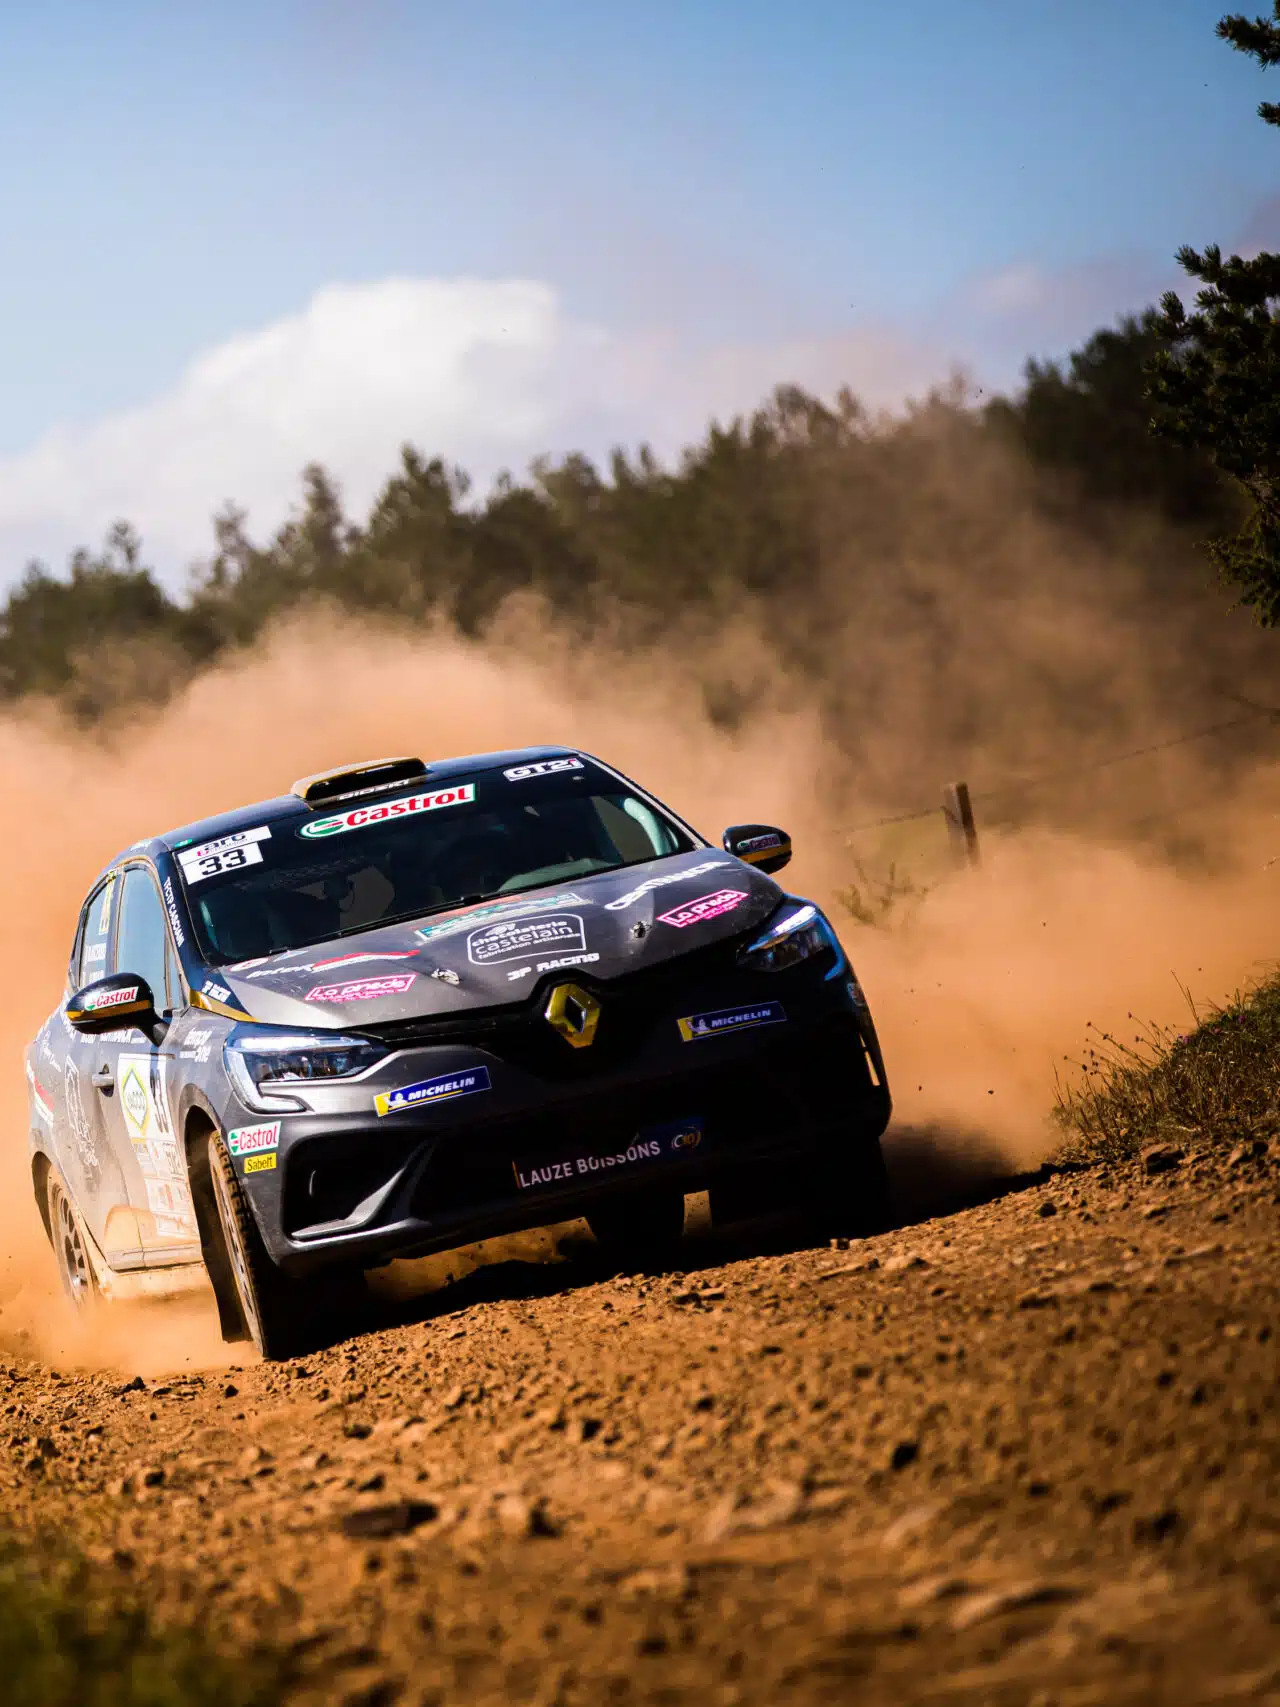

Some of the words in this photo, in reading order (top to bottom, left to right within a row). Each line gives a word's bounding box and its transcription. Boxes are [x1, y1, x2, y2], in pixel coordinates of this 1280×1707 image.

[346, 787, 471, 826] Castrol
[198, 849, 248, 876] 33
[471, 920, 568, 947] chocolaterie
[475, 924, 573, 955] castelain
[478, 940, 532, 960] fabrication
[532, 932, 582, 945] artisanale
[536, 953, 600, 973] RACING
[96, 988, 136, 1007] Castrol
[710, 1009, 772, 1028] MICHELIN
[407, 1076, 476, 1101] MICHELIN
[239, 1127, 279, 1151] Castrol
[246, 1155, 274, 1172] Sabelt
[519, 1161, 573, 1188] LAUZE
